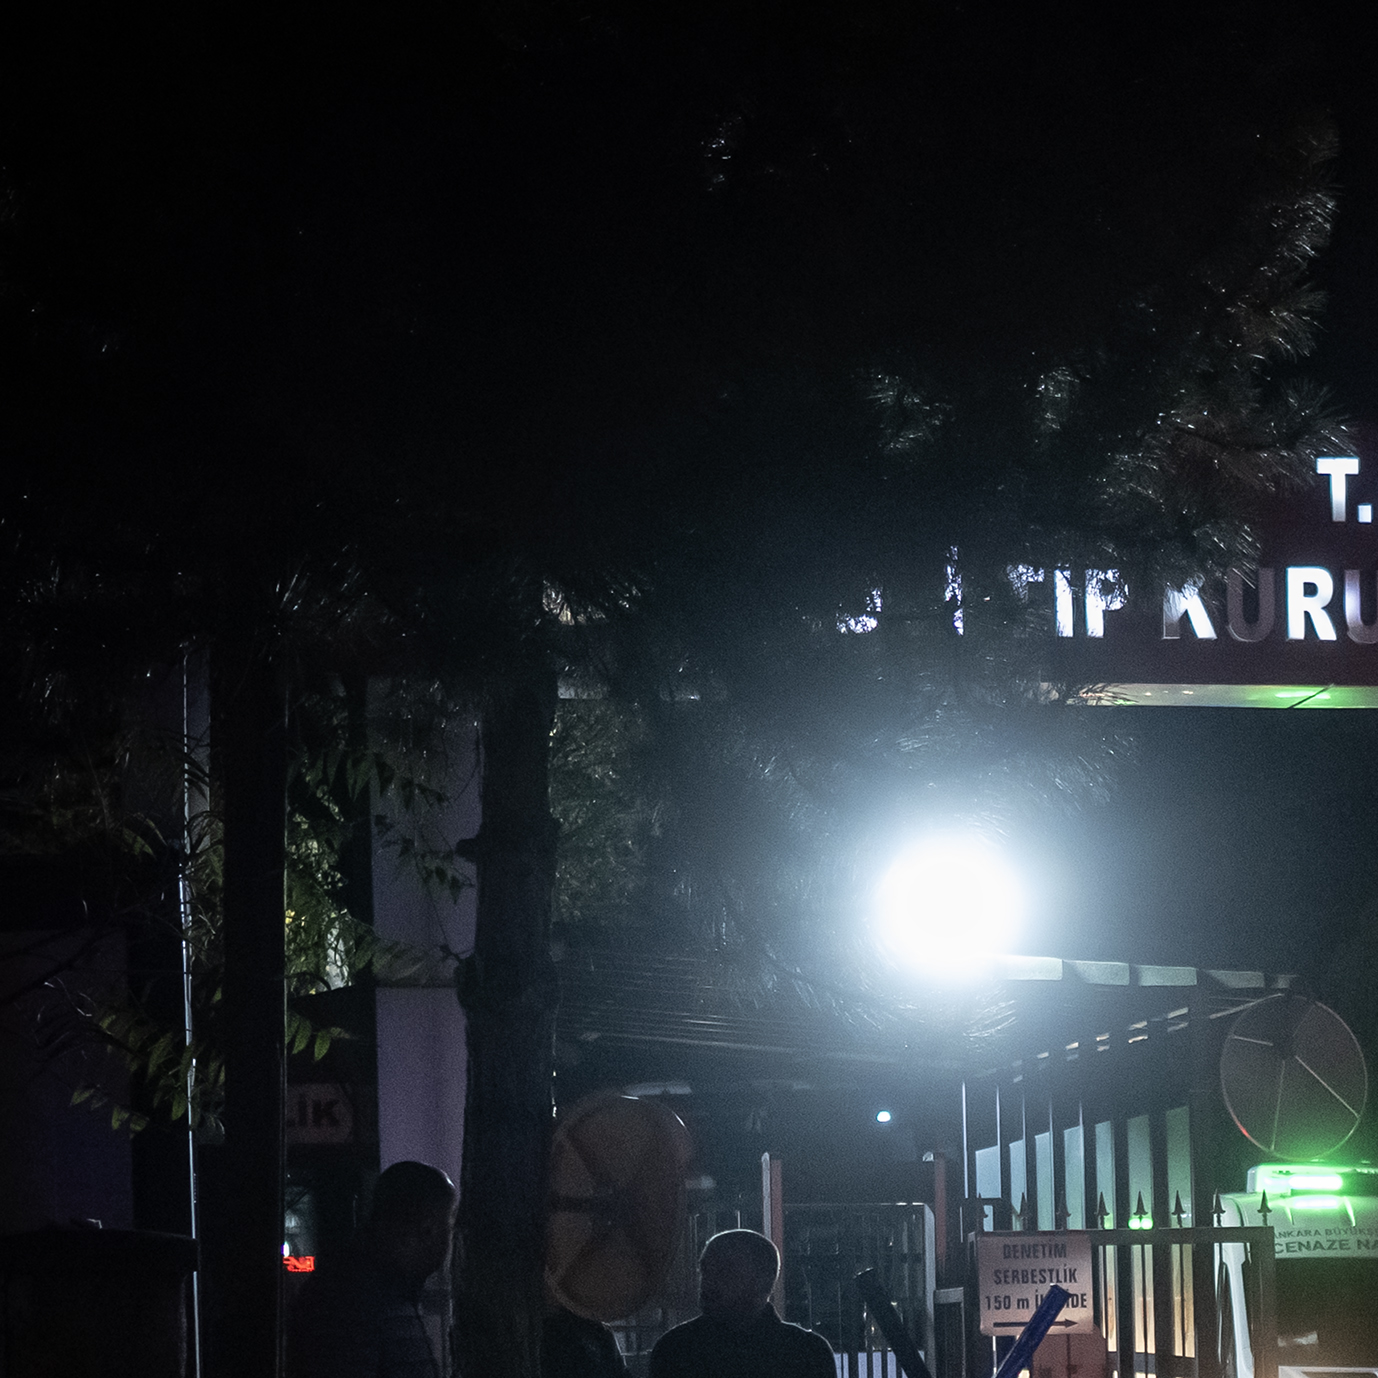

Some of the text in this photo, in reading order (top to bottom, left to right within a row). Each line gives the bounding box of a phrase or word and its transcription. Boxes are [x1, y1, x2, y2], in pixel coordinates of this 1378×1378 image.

[1003, 1240, 1068, 1260] DENETİM
[1275, 1238, 1351, 1254] CENAZE
[994, 1263, 1078, 1285] SERBESTLİK
[985, 1295, 1012, 1311] 150
[1017, 1297, 1029, 1309] m
